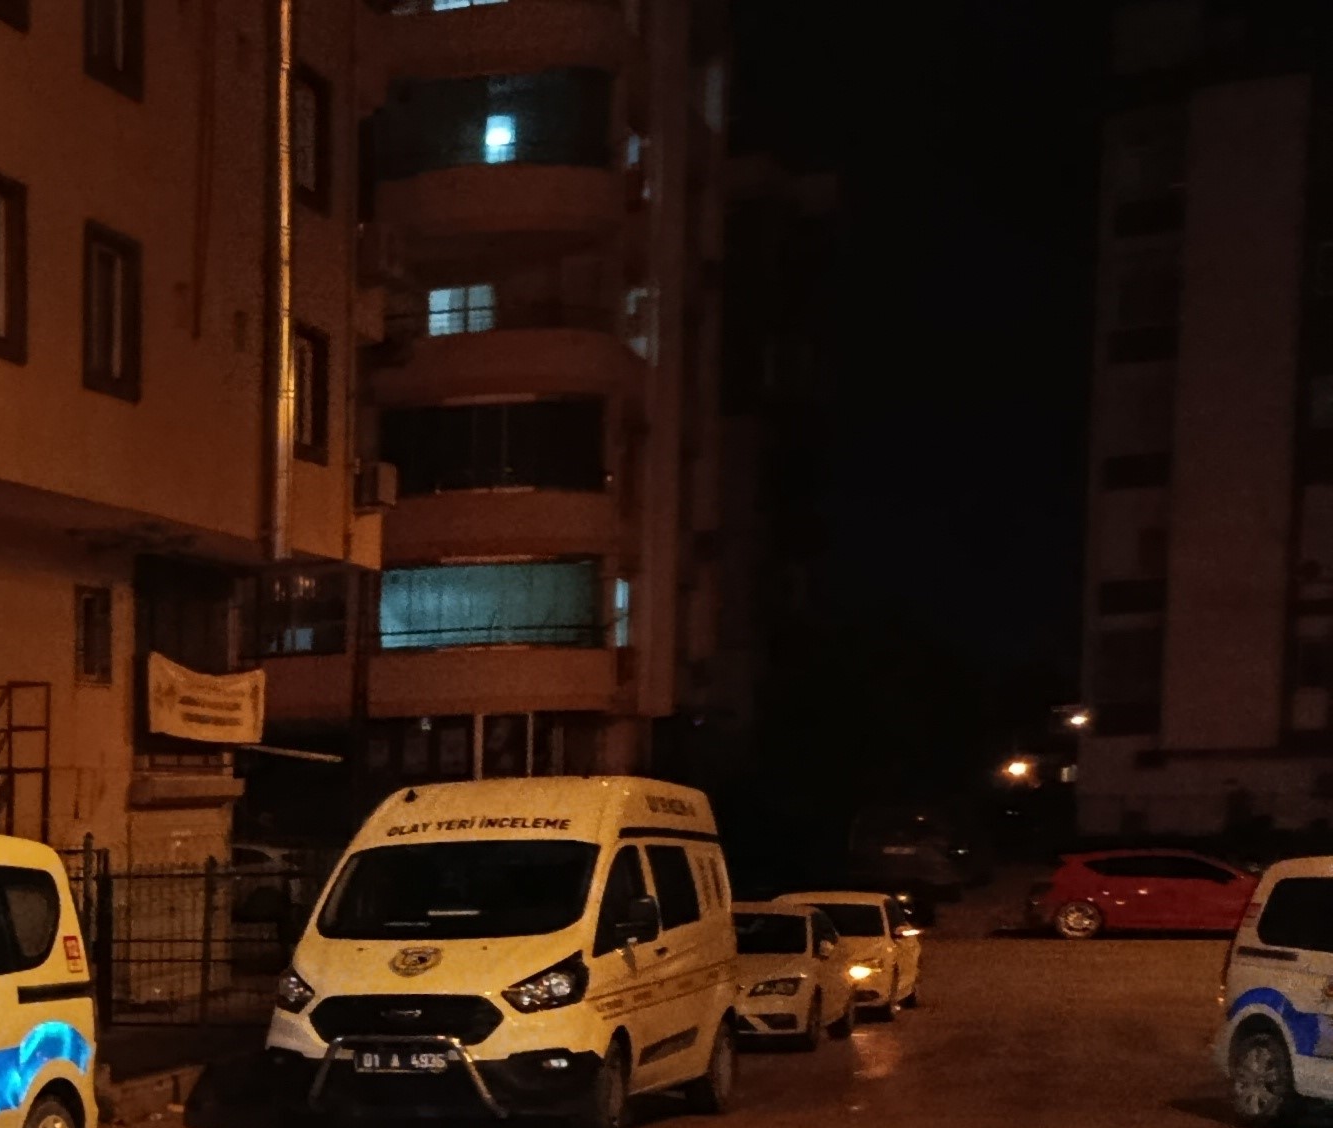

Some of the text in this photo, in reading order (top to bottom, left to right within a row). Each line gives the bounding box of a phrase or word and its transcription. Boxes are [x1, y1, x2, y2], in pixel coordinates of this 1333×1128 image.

[386, 815, 573, 837] OLAY YERİ İNCELEME
[363, 1053, 380, 1068] 01
